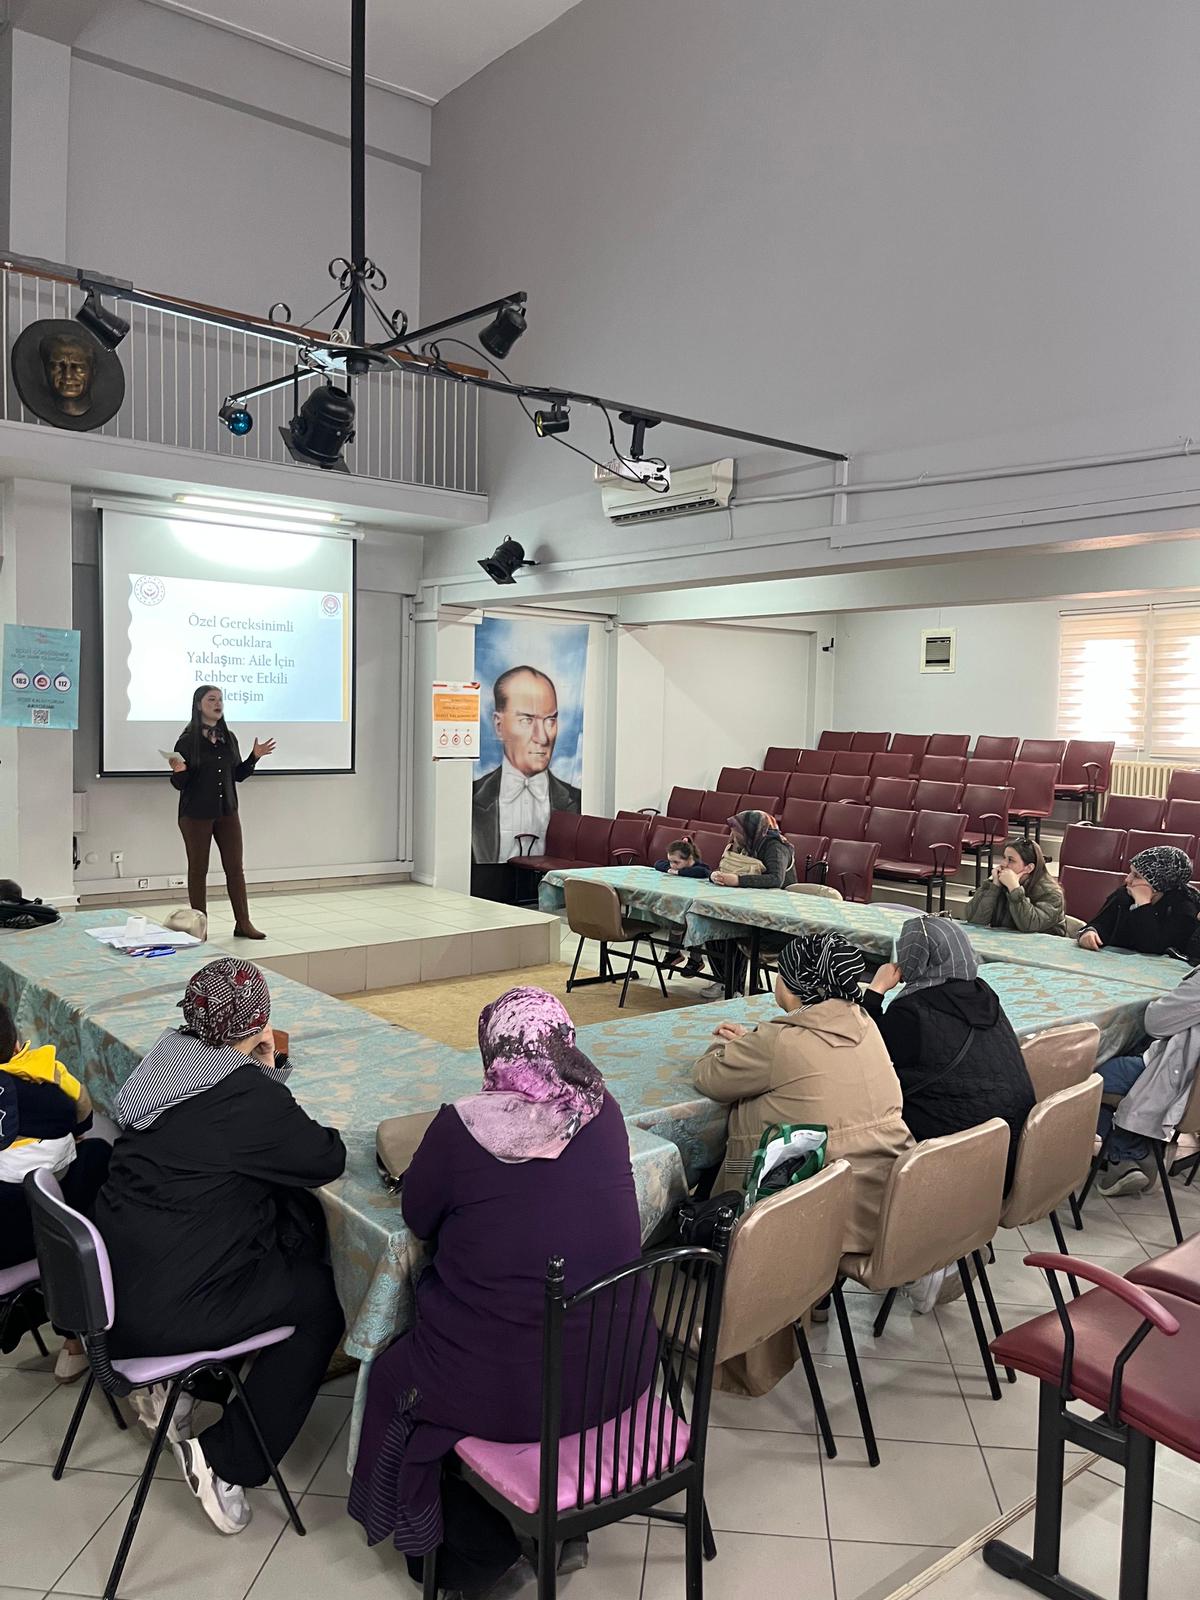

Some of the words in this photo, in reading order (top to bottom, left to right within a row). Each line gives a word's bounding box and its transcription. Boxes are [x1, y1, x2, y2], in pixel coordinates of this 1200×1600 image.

[188, 612, 217, 628] Özel
[219, 616, 294, 633] Gereksinimli
[212, 634, 272, 649] Çocuklara
[187, 651, 246, 667] Yaklaşım:
[248, 654, 272, 667] Aile
[58, 680, 68, 688] 112
[194, 669, 238, 684] Rehber
[240, 674, 254, 684] ve
[256, 672, 288, 685] Etkili
[221, 687, 264, 704] letişim
